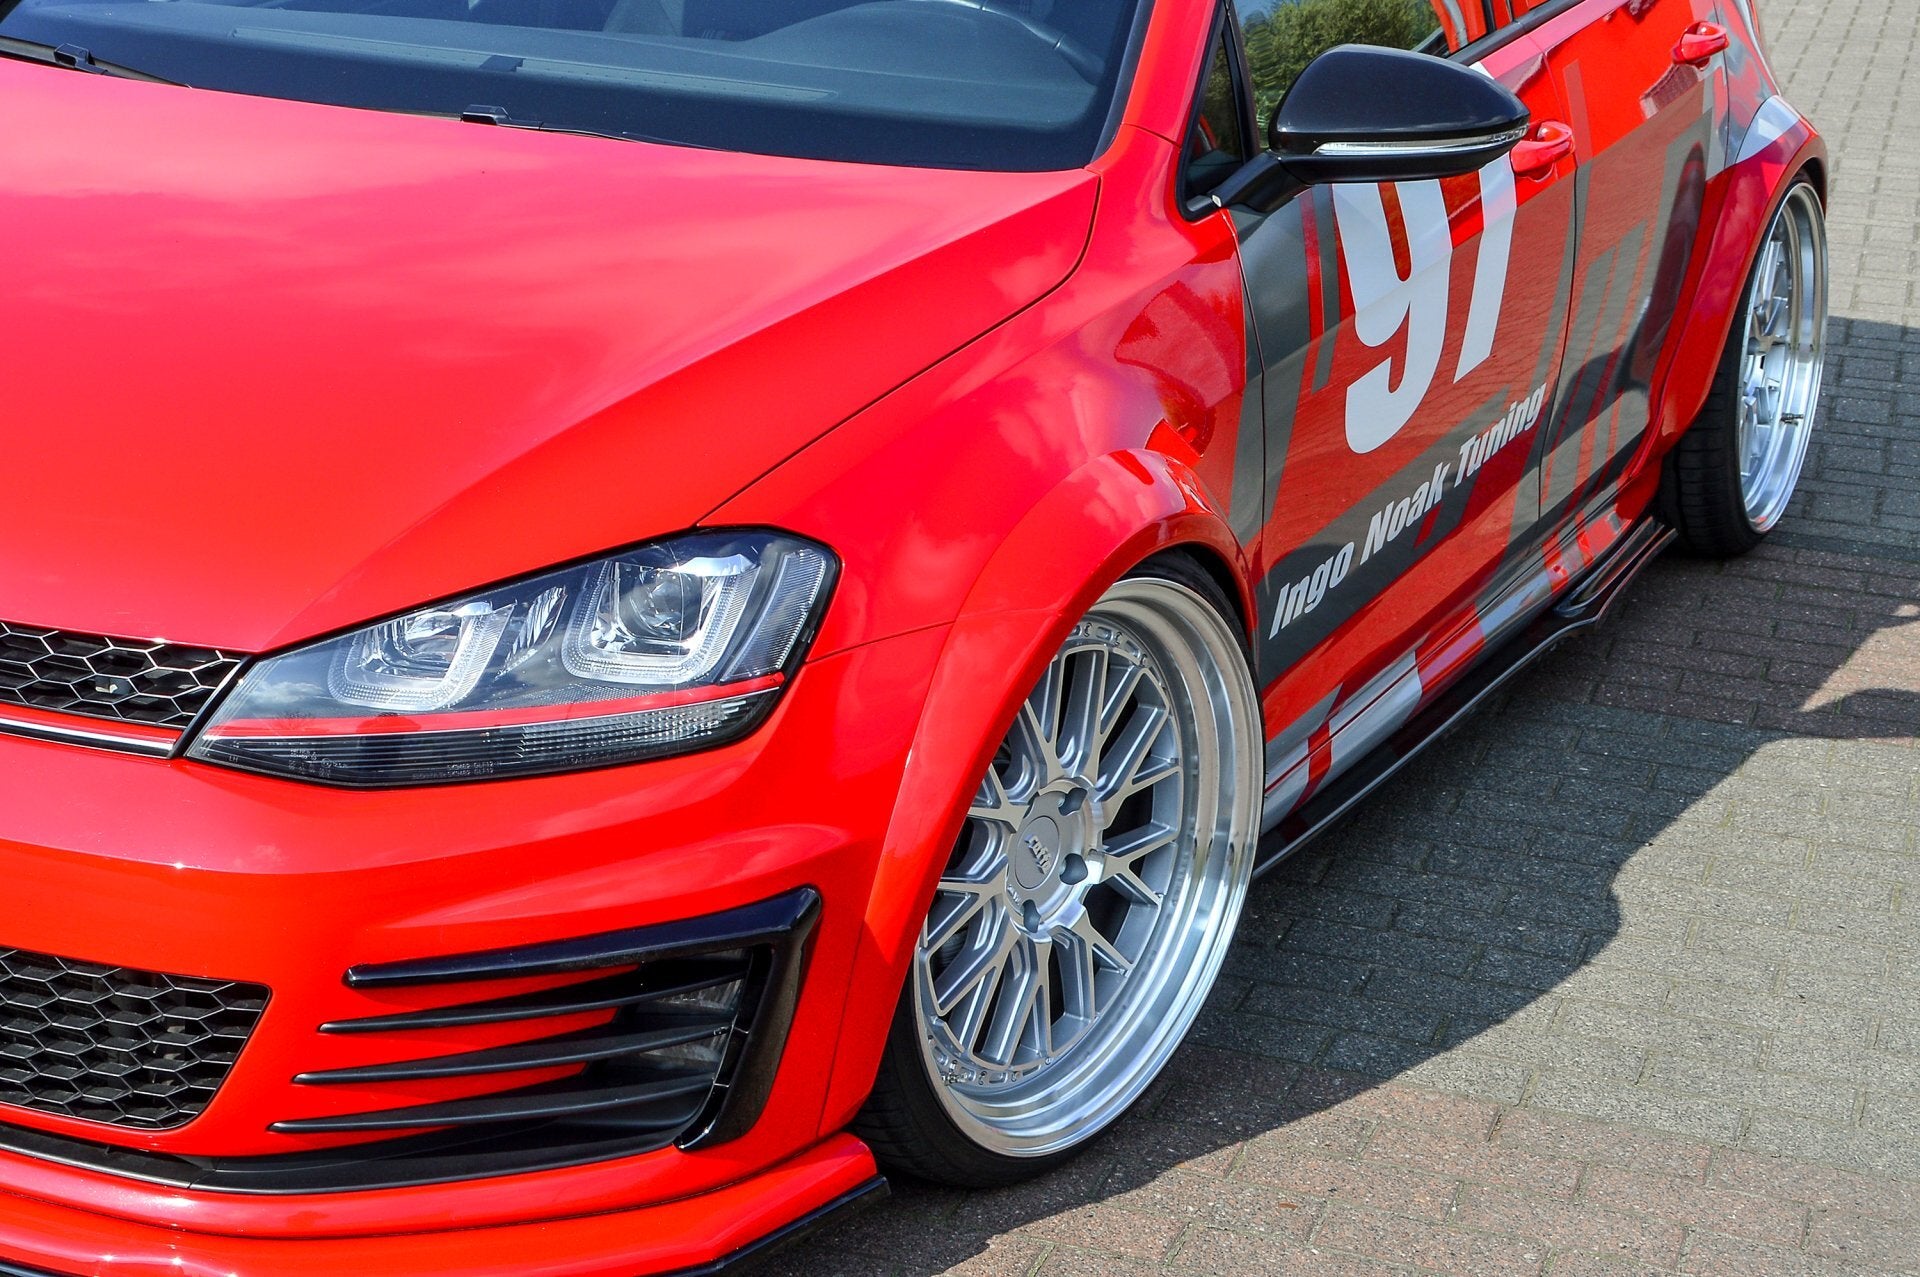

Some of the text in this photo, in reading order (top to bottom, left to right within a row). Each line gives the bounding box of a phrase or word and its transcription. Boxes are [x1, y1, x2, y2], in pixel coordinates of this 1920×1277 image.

[1269, 383, 1547, 639] Ingo Noak Tuning
